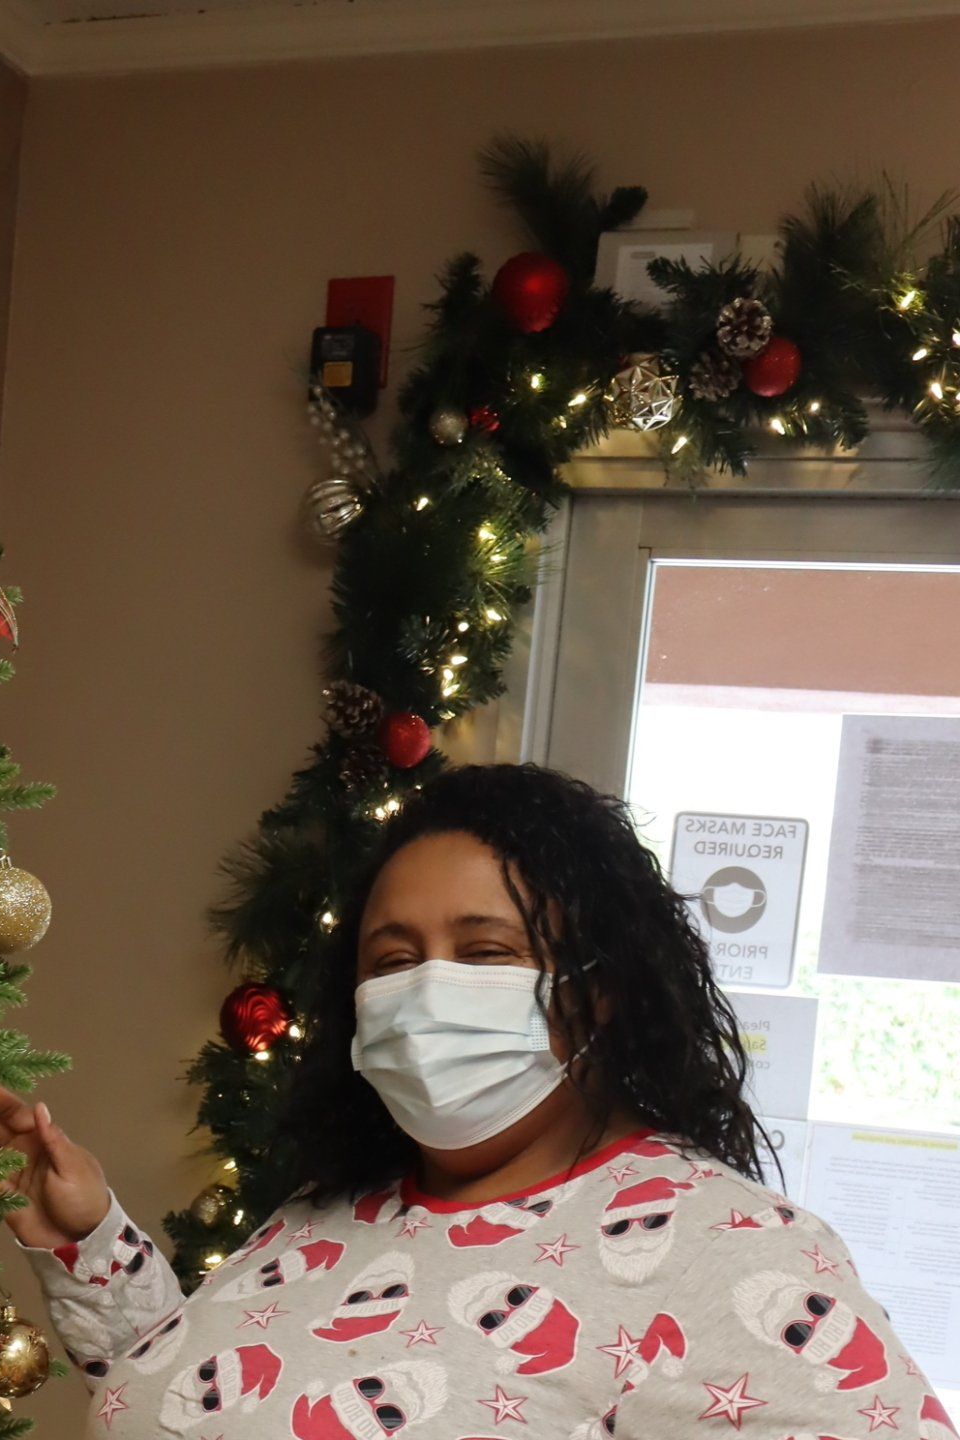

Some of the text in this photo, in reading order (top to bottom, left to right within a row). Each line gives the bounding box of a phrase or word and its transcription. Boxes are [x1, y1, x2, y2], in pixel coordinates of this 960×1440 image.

[821, 1322, 844, 1343] HO
[806, 1337, 832, 1359] HO
[342, 1400, 364, 1423] HO
